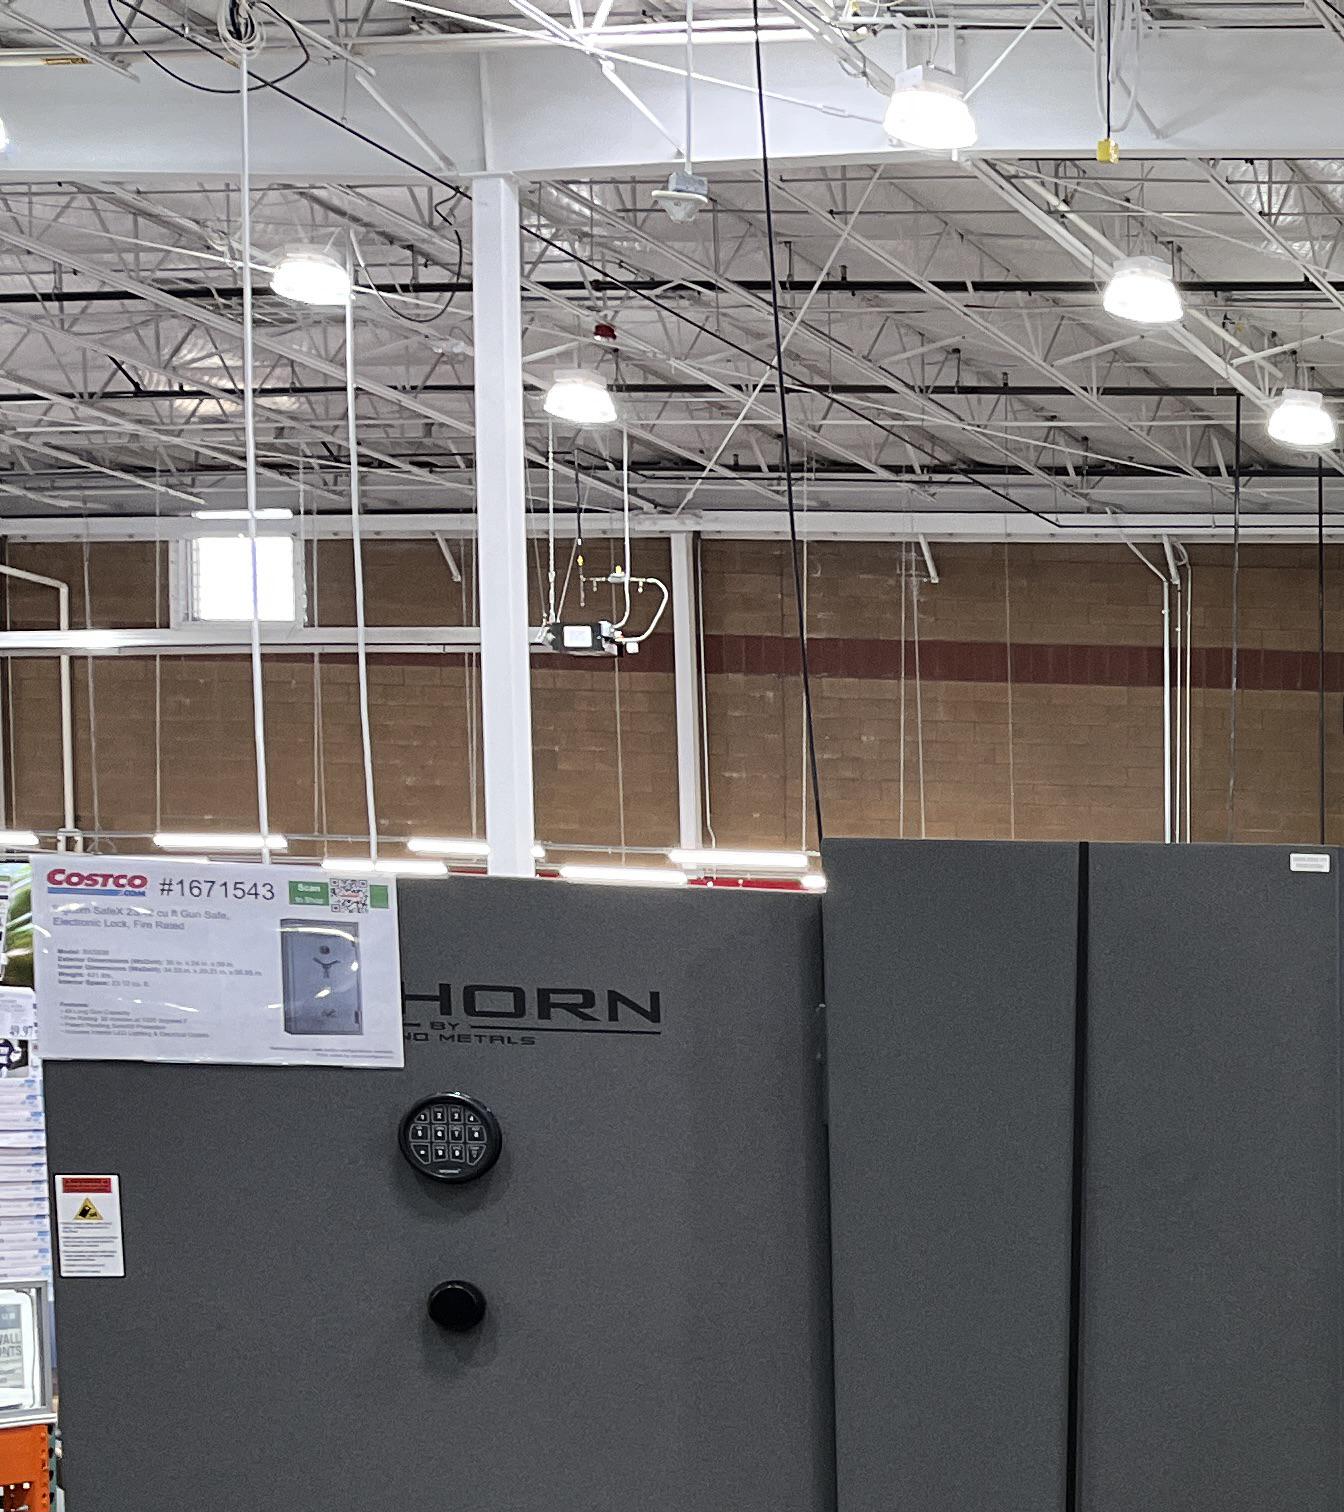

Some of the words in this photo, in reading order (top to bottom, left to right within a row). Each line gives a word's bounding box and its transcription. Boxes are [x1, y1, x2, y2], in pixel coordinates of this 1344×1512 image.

[47, 868, 149, 889] COSTCO
[159, 878, 275, 900] #1671543
[180, 909, 201, 918] Gun
[53, 917, 102, 926] Electronic
[104, 919, 130, 929] Lock,
[156, 920, 185, 930] Rated
[430, 1022, 460, 1031] BY
[439, 1033, 536, 1045] METALS
